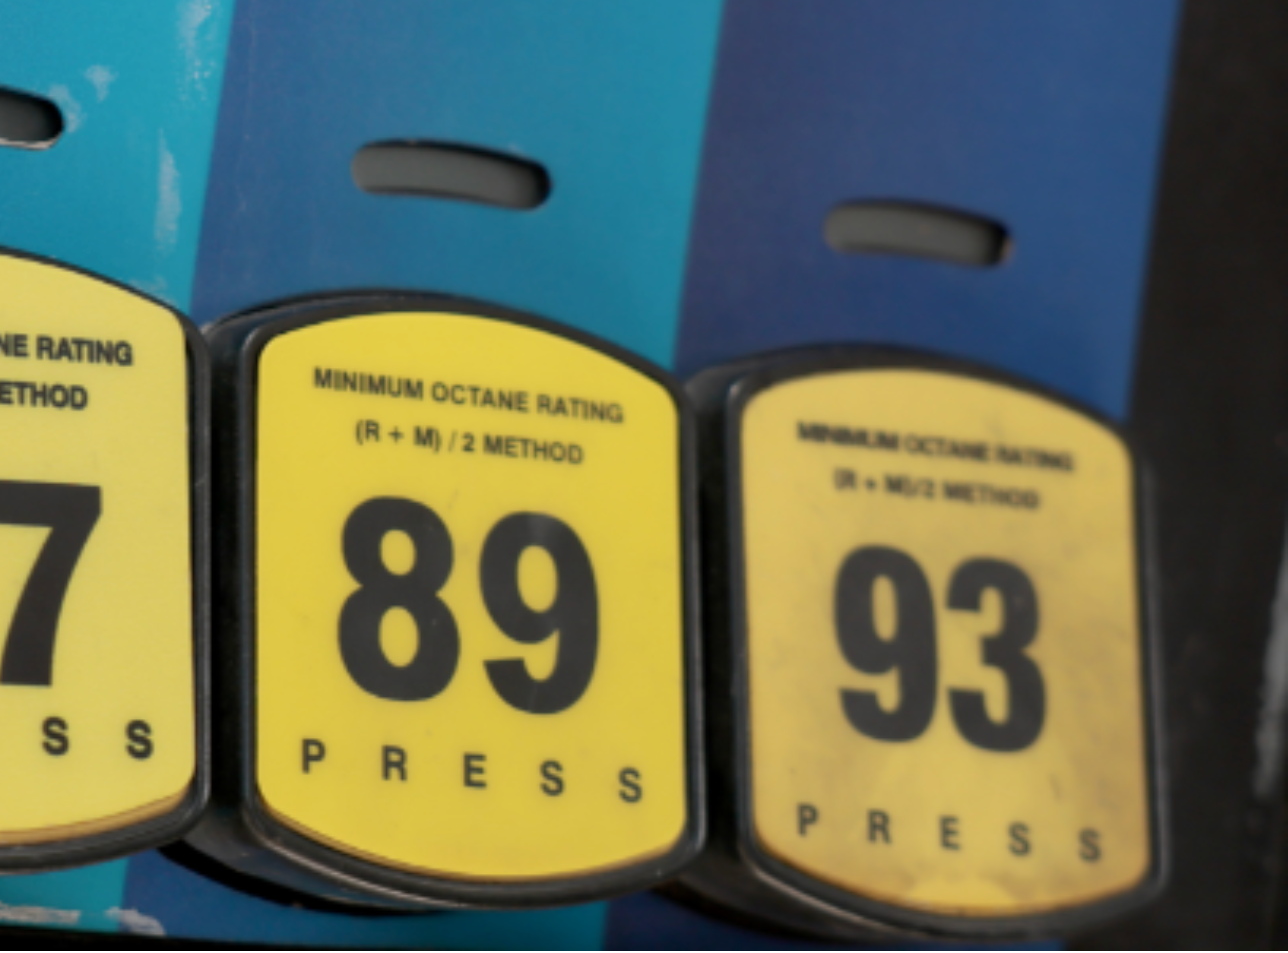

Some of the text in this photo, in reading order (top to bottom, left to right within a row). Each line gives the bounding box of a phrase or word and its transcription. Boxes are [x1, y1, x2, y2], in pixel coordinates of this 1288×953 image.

[36, 336, 134, 366] RATING
[313, 368, 624, 423] MINIMUM OCTANE RATING
[355, 420, 380, 446] (R
[388, 426, 403, 441] +
[483, 436, 584, 464] METHOD
[796, 421, 1076, 473] MINIMUM OCTANE RATING
[942, 480, 1040, 510] METHOD
[338, 495, 599, 716] 89
[833, 543, 1047, 754] 93
[302, 737, 643, 803] PRESS
[796, 804, 1101, 864] PRESS
